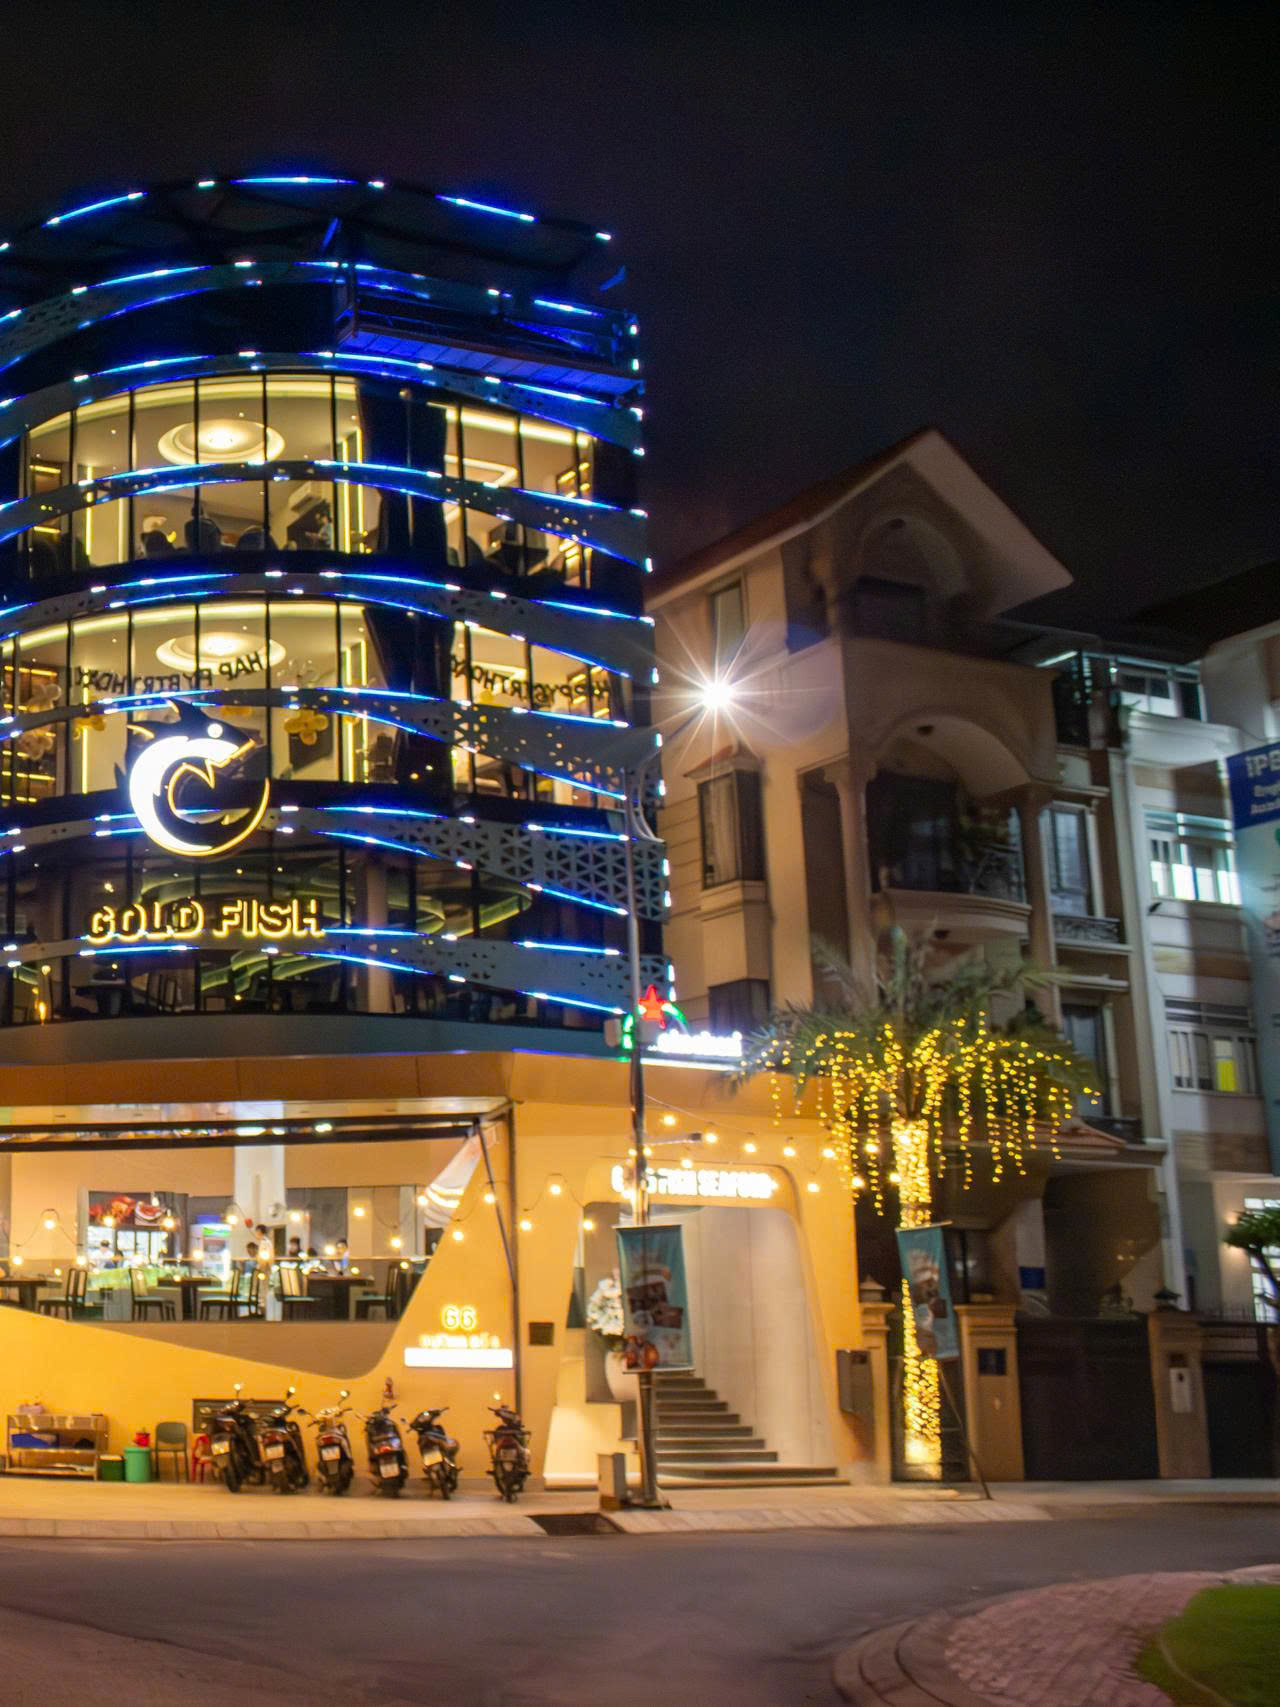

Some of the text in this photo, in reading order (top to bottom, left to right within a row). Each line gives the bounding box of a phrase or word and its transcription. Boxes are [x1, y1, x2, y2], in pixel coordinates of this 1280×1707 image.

[86, 899, 326, 944] GOLD FISH
[442, 1305, 478, 1332] 66
